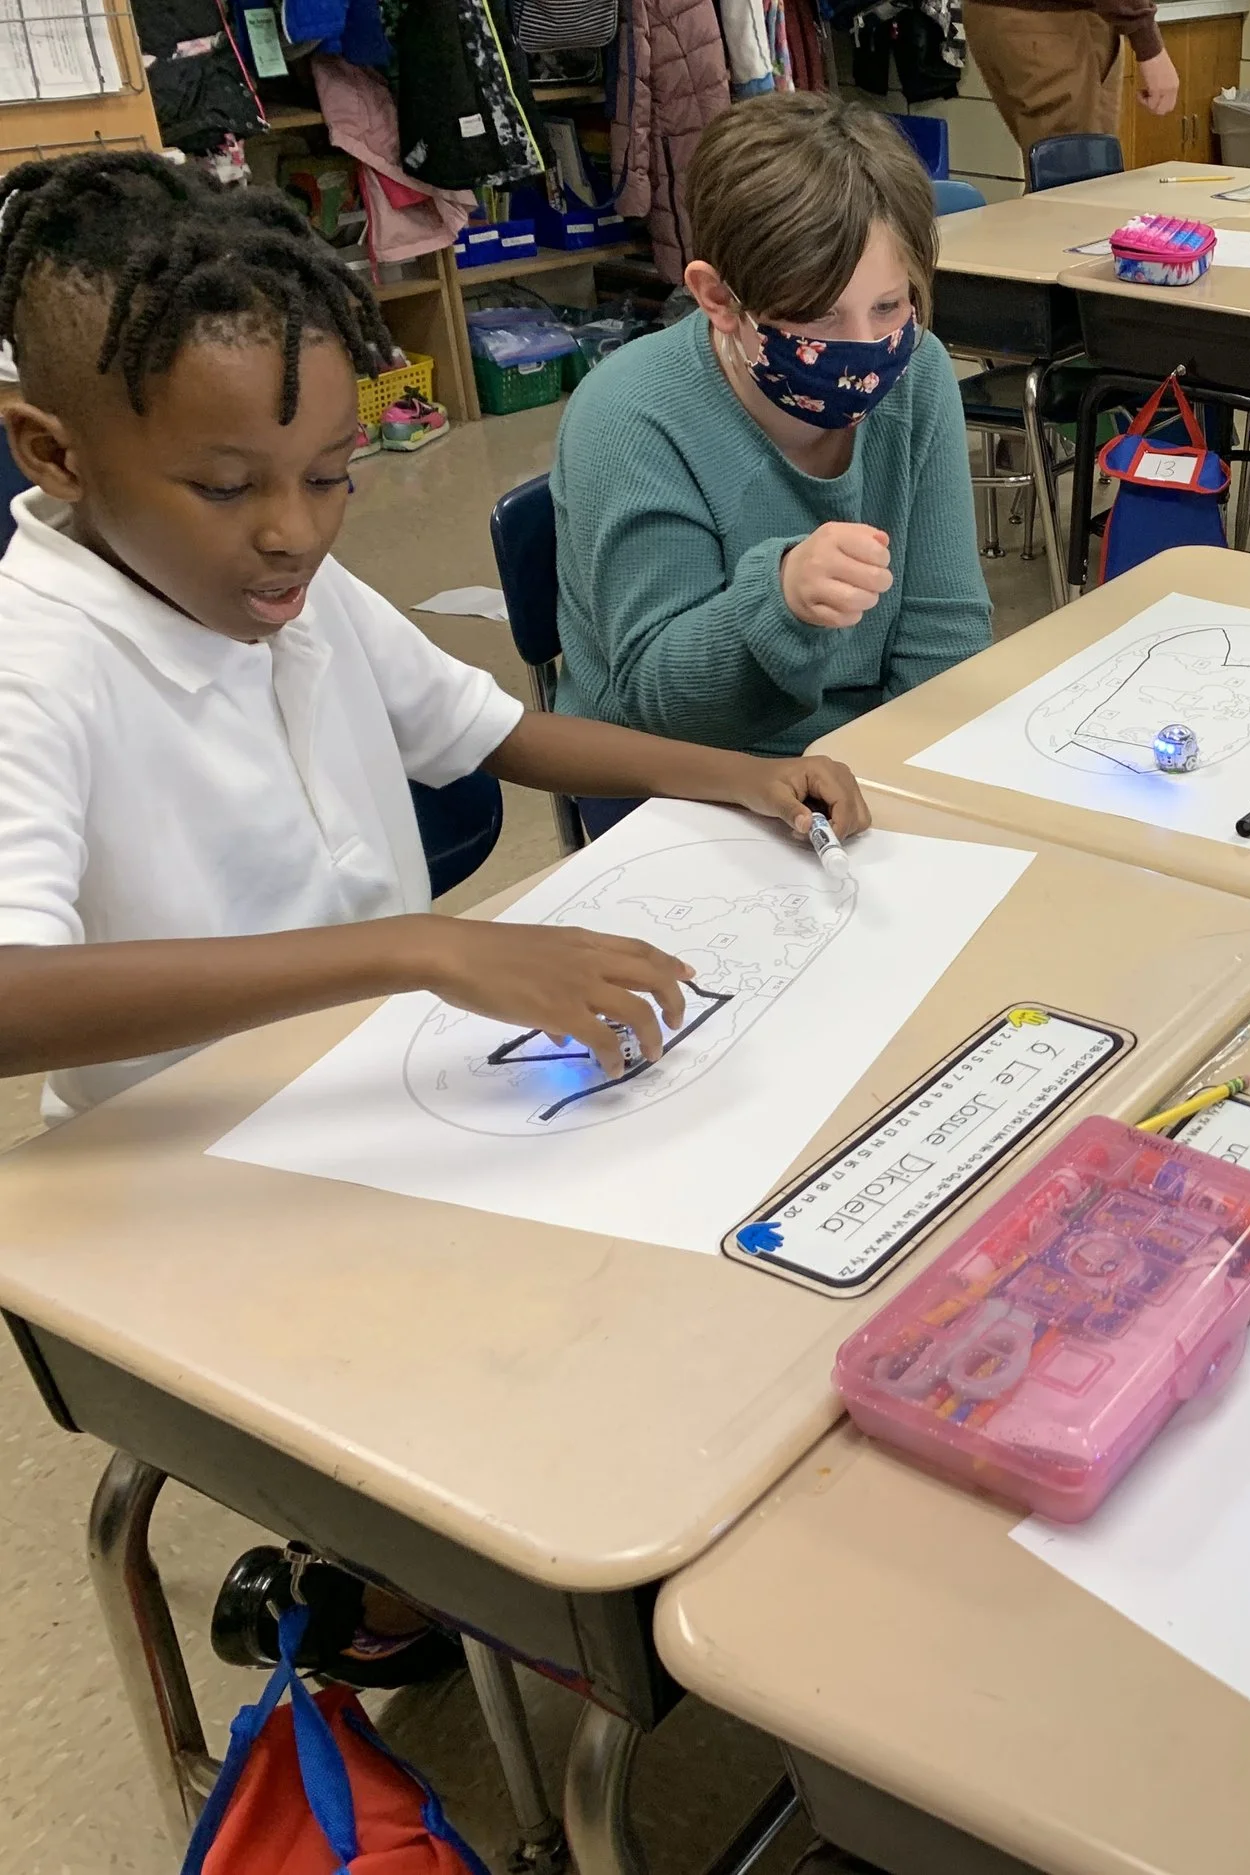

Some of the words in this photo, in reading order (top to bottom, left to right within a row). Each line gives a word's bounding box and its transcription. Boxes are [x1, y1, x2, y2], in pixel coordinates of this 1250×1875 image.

[1155, 459, 1176, 478] 13
[1031, 1042, 1059, 1060] 6
[918, 1099, 933, 1109] 10
[895, 1117, 911, 1127] 12
[926, 1091, 998, 1146] Josue
[883, 1128, 898, 1137] 13
[870, 1138, 886, 1148] 14
[857, 1149, 873, 1158] 15
[843, 1160, 859, 1169] 16
[831, 1170, 846, 1181] 17
[815, 1182, 831, 1192] 18
[801, 1193, 817, 1203] 19
[822, 1153, 936, 1233] Dikolela
[783, 1205, 803, 1219] 20
